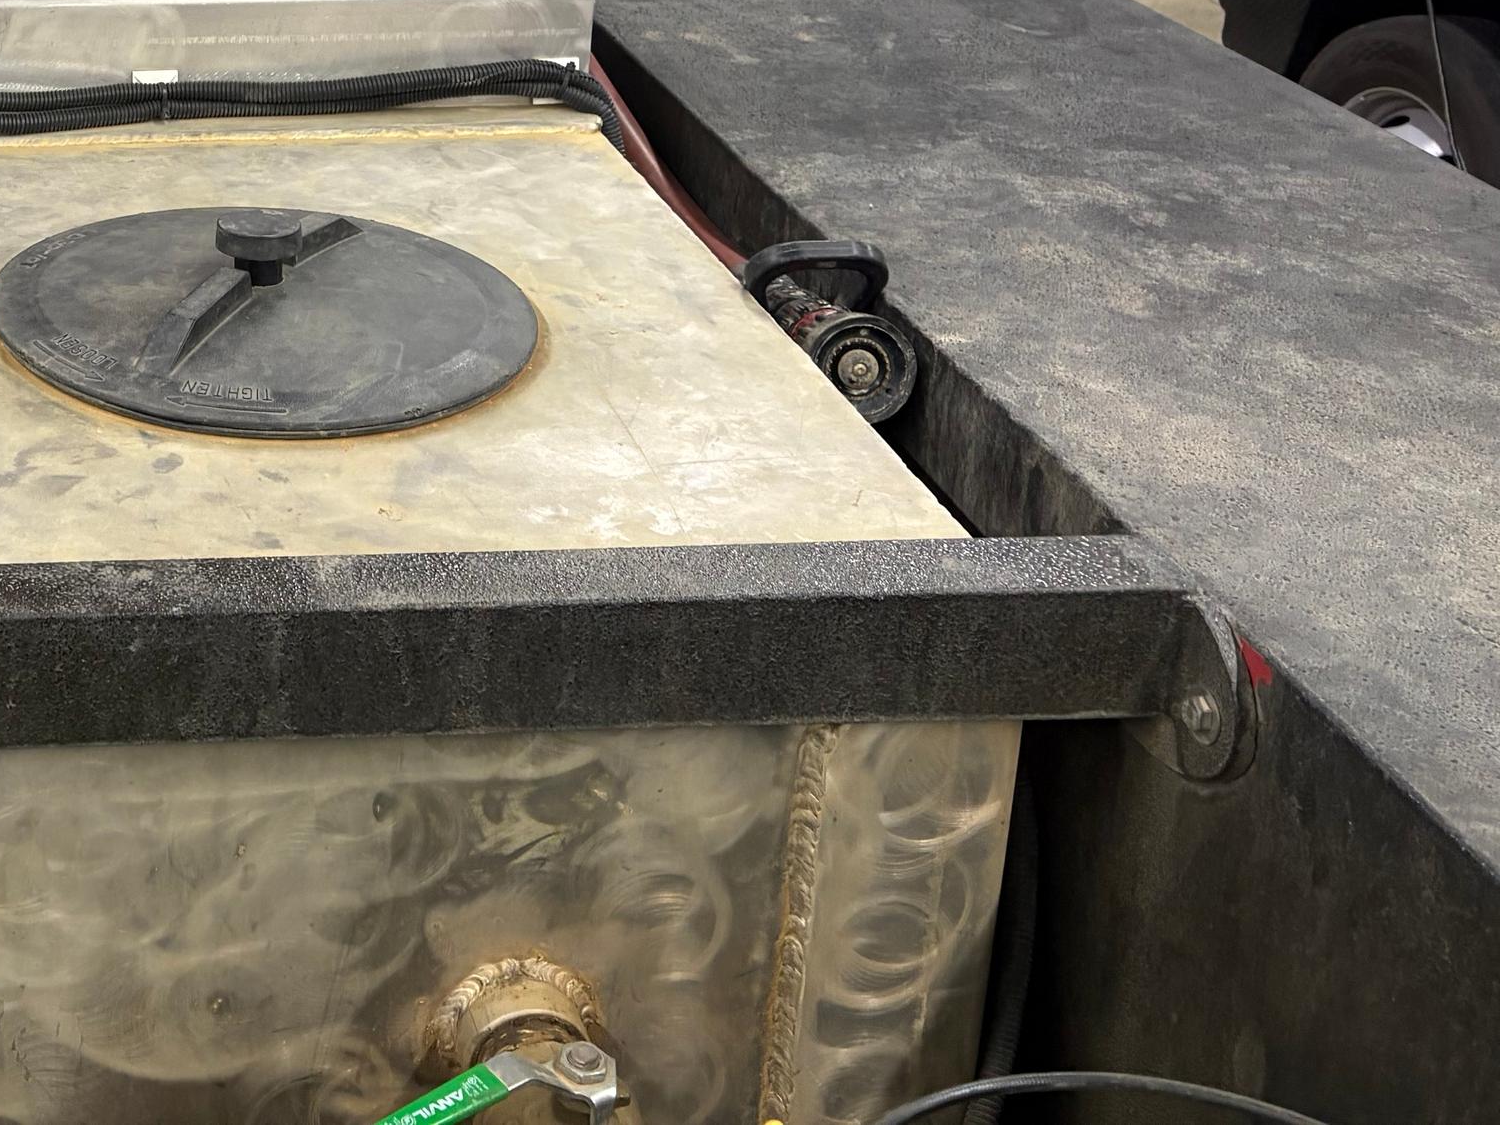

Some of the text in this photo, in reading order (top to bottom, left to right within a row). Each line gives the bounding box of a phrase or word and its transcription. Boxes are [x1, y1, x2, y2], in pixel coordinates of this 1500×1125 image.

[53, 332, 118, 371] LOOSEN
[181, 379, 274, 402] TIGHTEN
[411, 1087, 464, 1119] ANVIL
